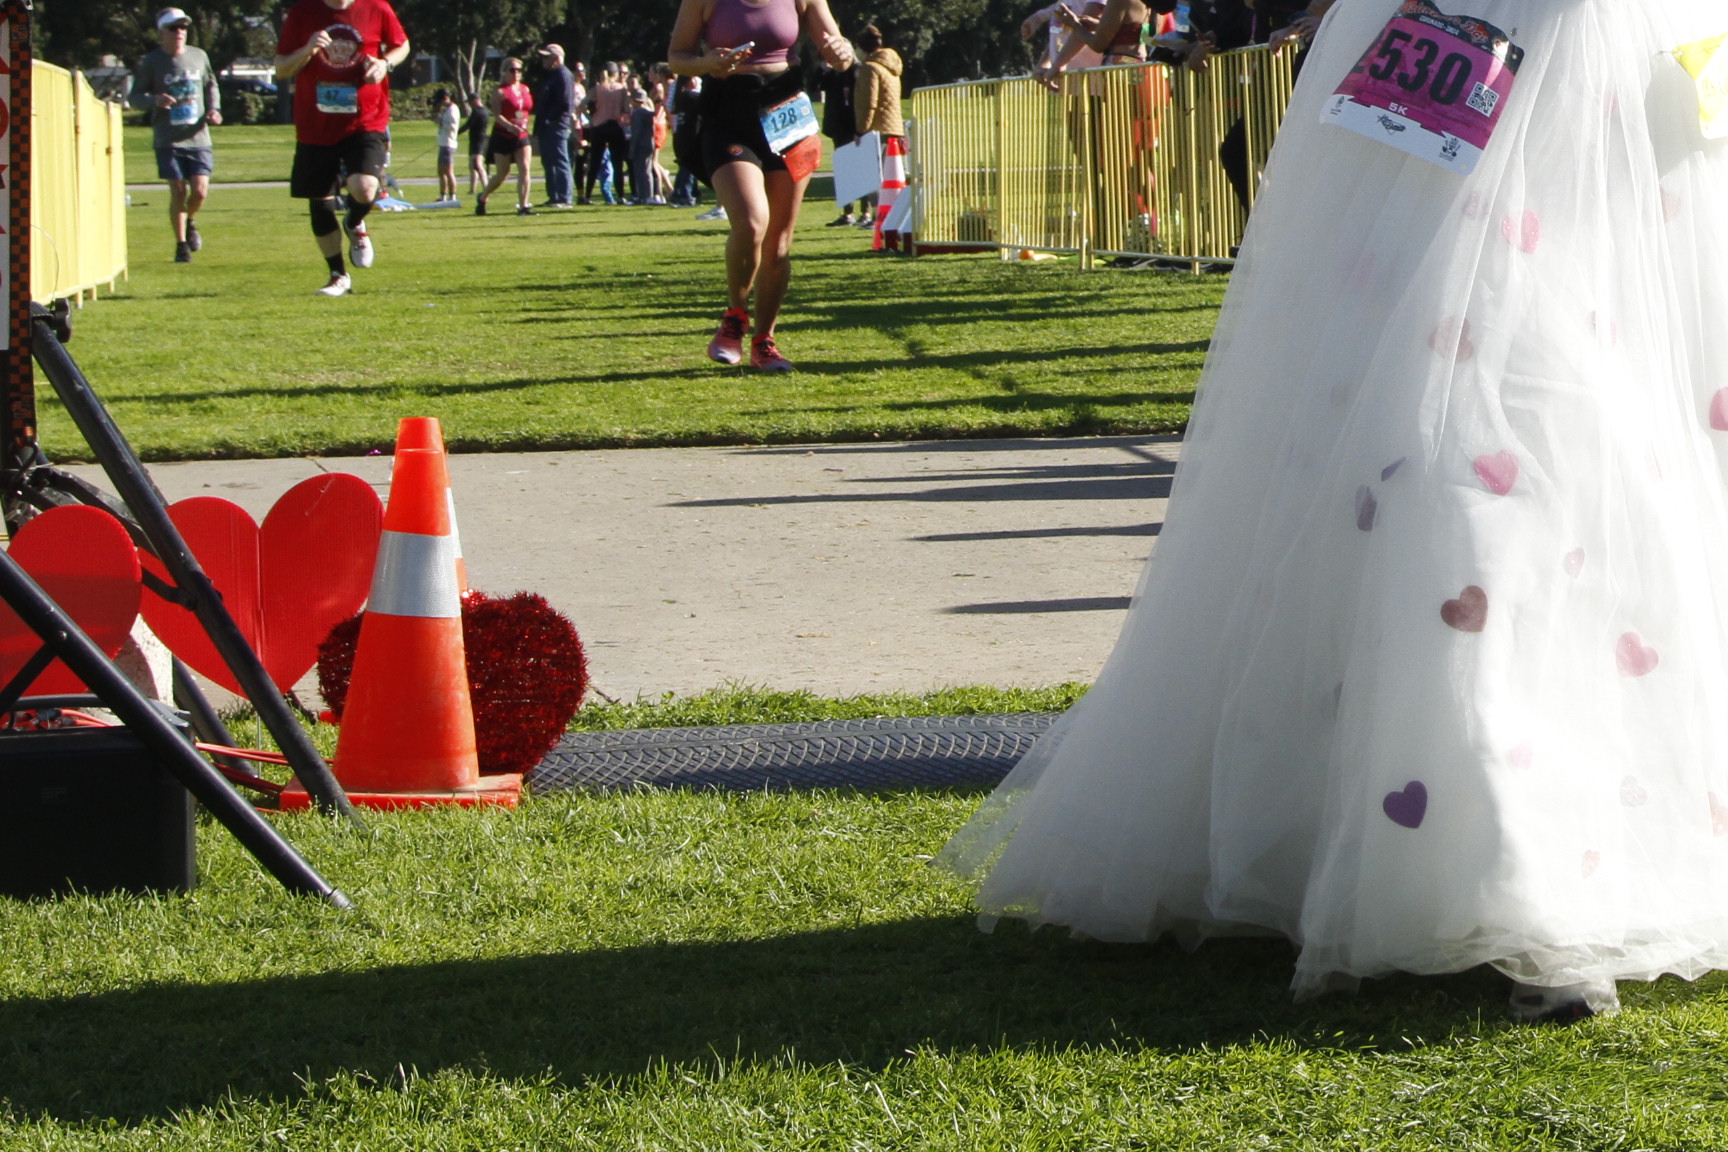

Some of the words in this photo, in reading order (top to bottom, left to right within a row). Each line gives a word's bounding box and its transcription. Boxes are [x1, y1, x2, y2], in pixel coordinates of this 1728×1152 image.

[1350, 28, 1473, 106] 530
[771, 108, 797, 133] 128
[1388, 101, 1409, 116] 5K
